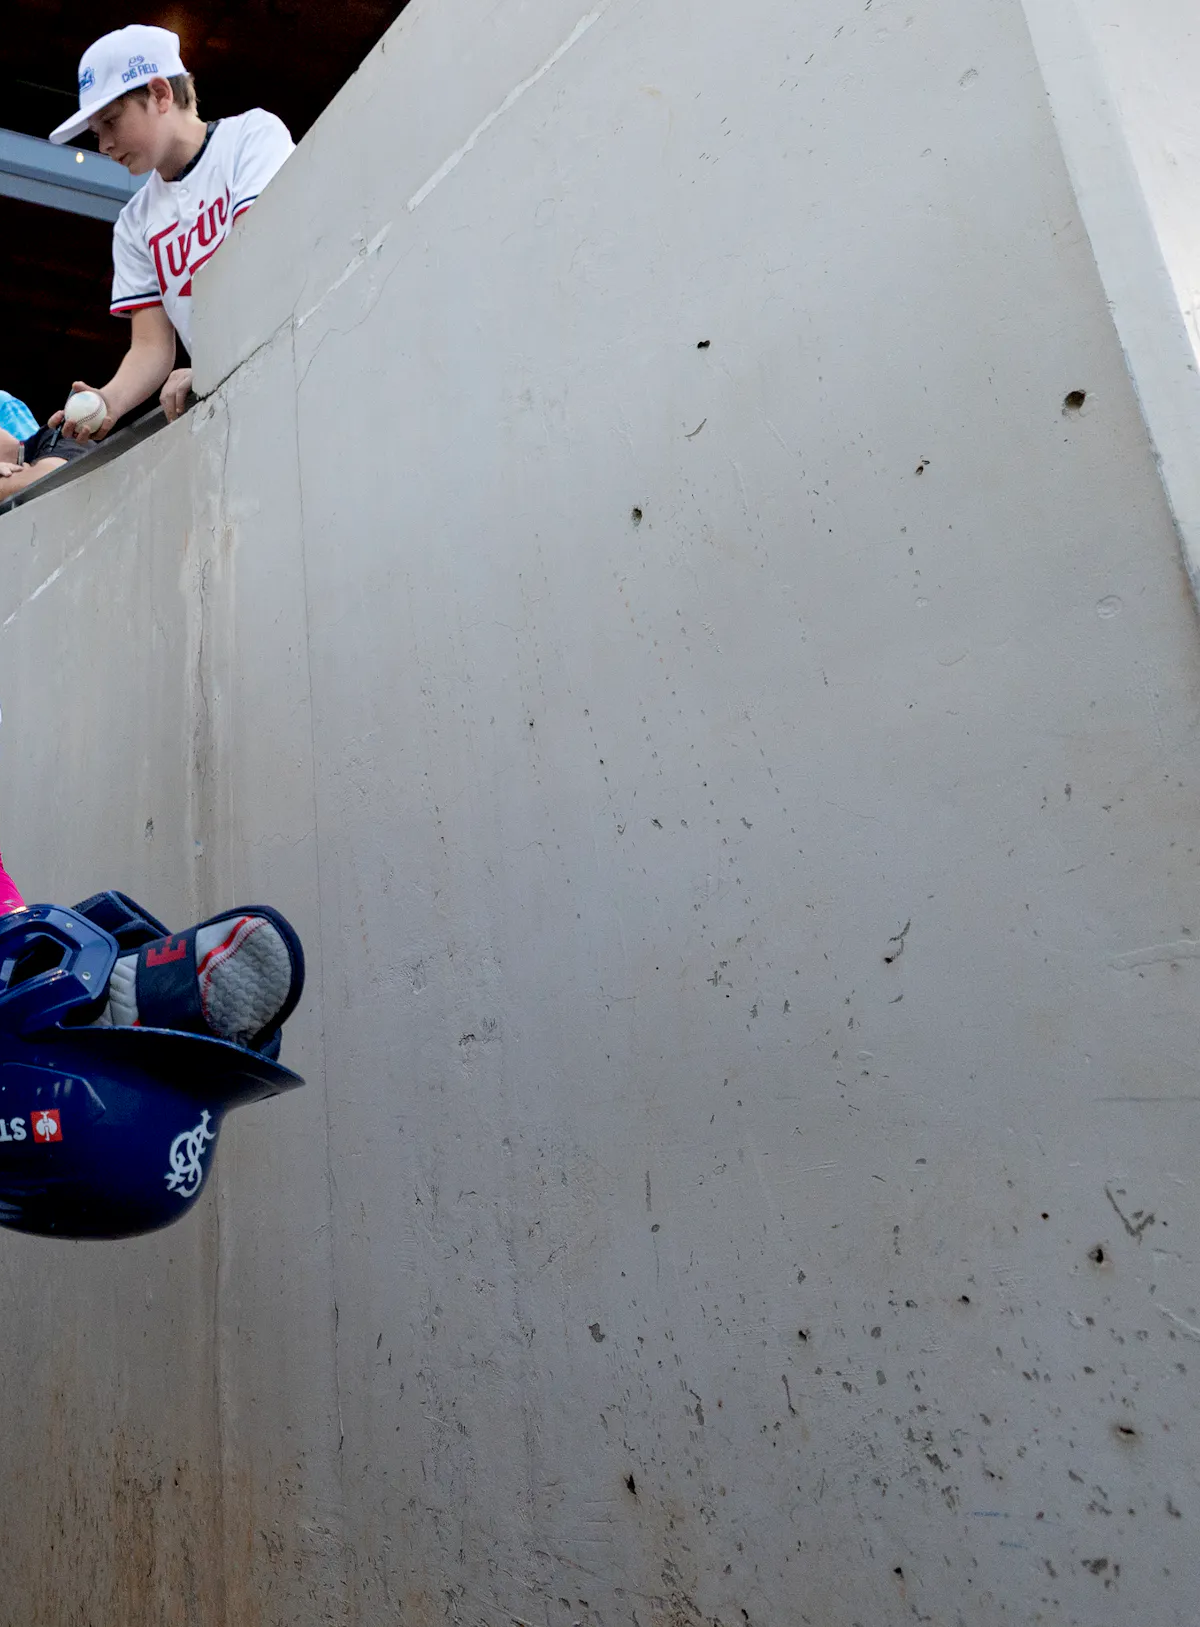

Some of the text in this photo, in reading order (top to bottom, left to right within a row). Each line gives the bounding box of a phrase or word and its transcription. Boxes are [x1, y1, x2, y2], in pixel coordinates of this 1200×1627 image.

[122, 63, 158, 83] CHS FIELD
[149, 183, 230, 296] Twin
